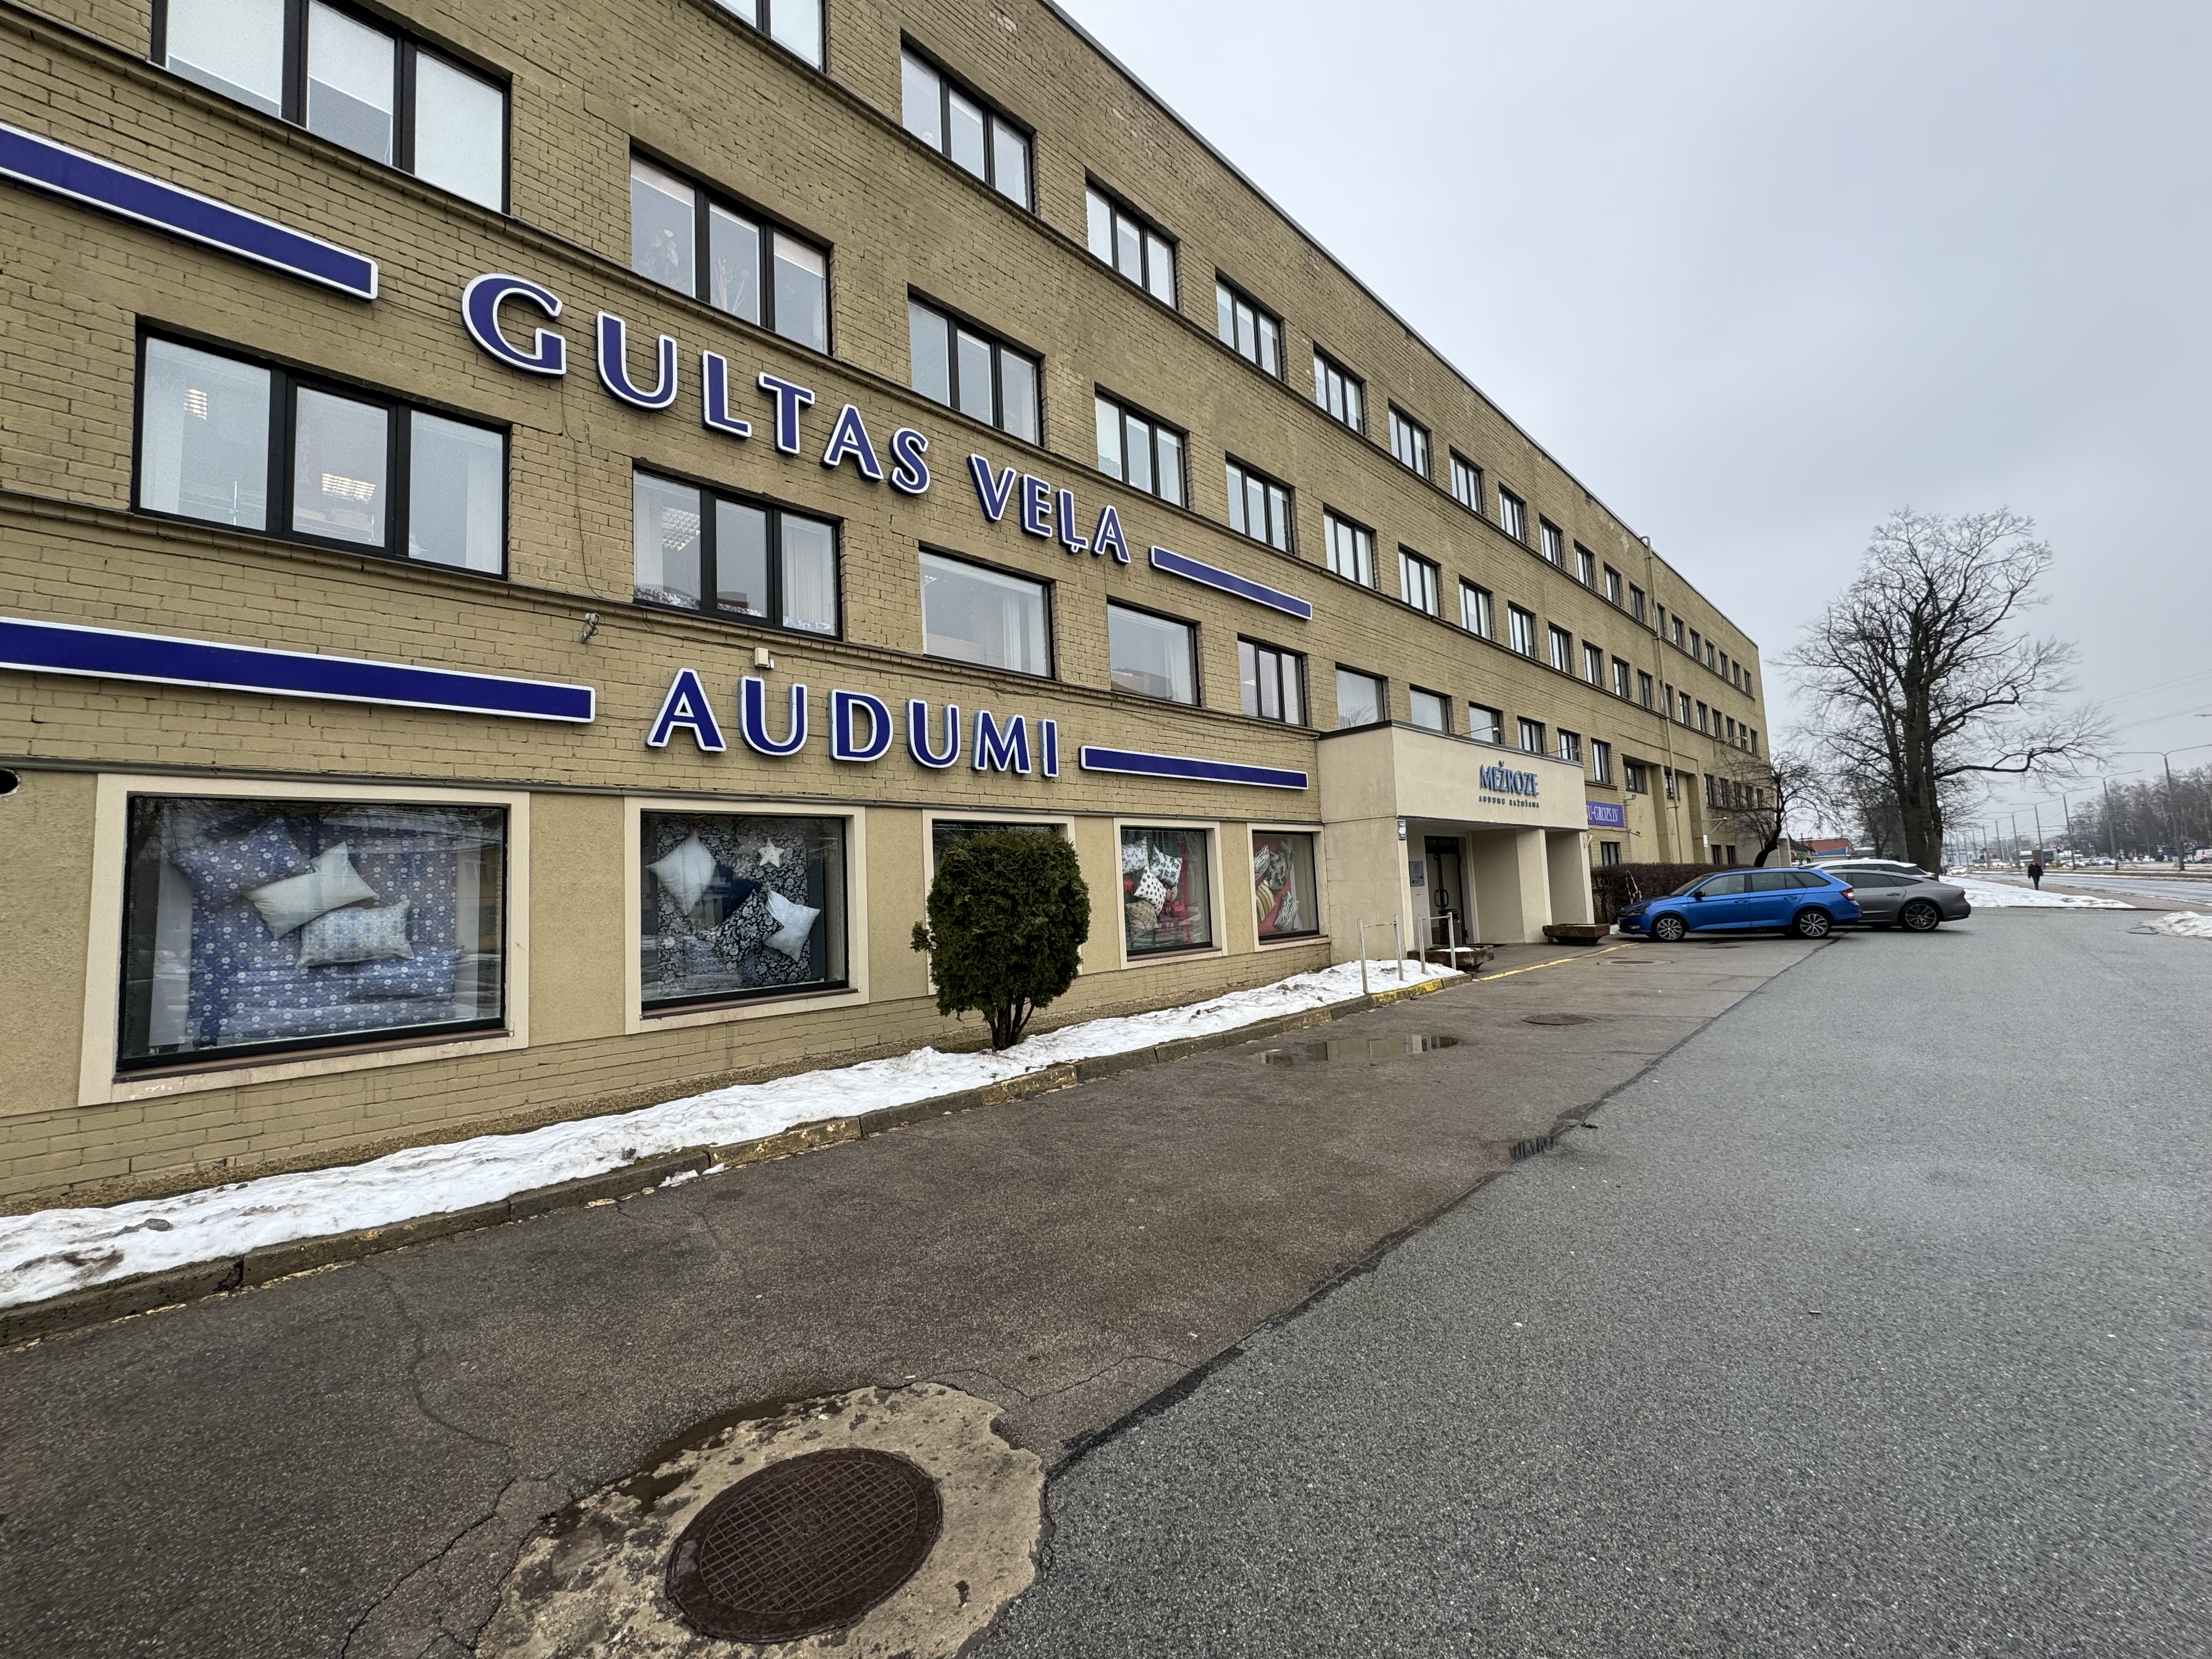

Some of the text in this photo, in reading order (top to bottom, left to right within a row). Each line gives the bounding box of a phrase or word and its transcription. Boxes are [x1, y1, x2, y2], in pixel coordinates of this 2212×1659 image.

[461, 273, 1131, 565] GULTAS VEĻA
[645, 668, 1060, 778] AUDUMI
[1480, 760, 1539, 797] MEŽROZE
[1585, 805, 1618, 822] U-GROZS.LV
